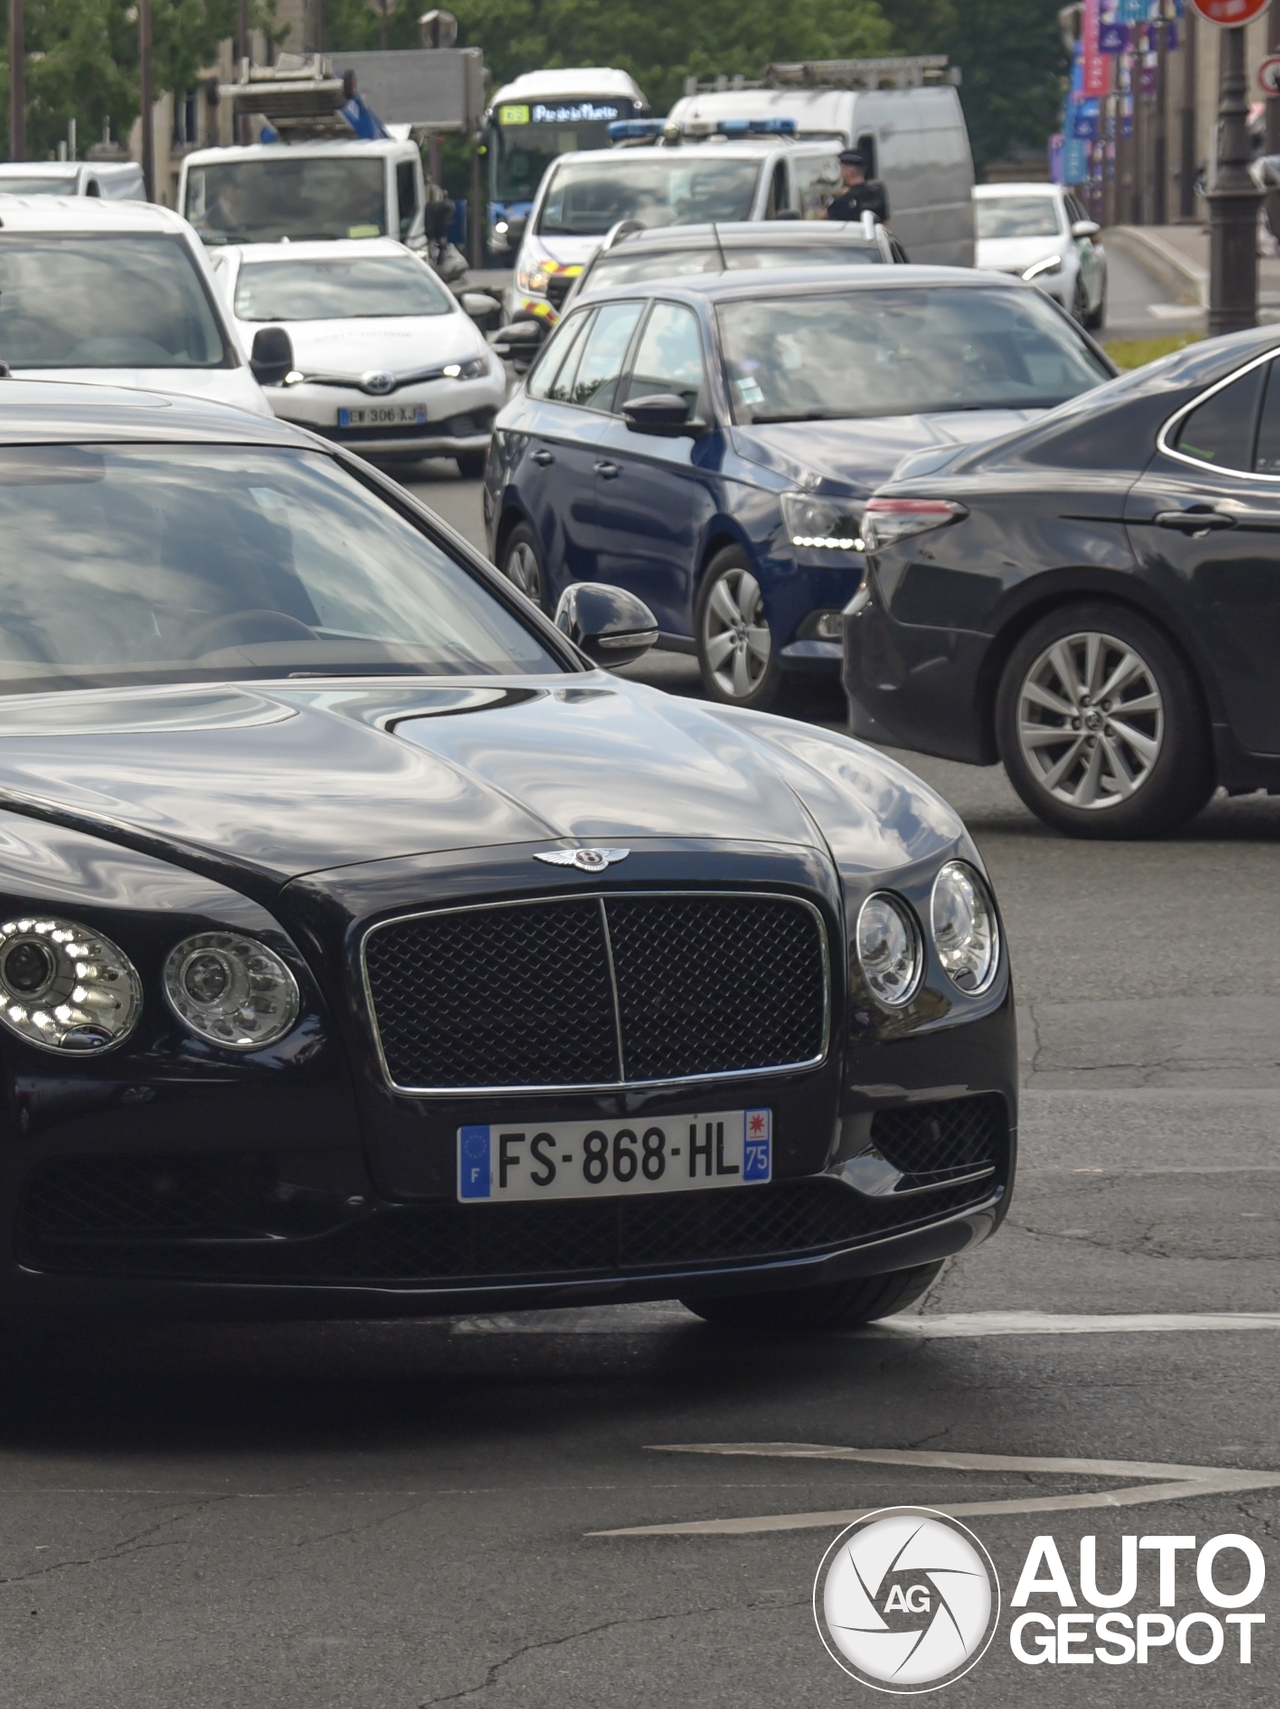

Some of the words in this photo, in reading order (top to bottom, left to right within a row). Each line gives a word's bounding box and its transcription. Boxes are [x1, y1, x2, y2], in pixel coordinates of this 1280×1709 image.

[471, 1168, 480, 1183] F
[498, 1121, 740, 1189] FS-868-HL
[746, 1145, 768, 1171] 75
